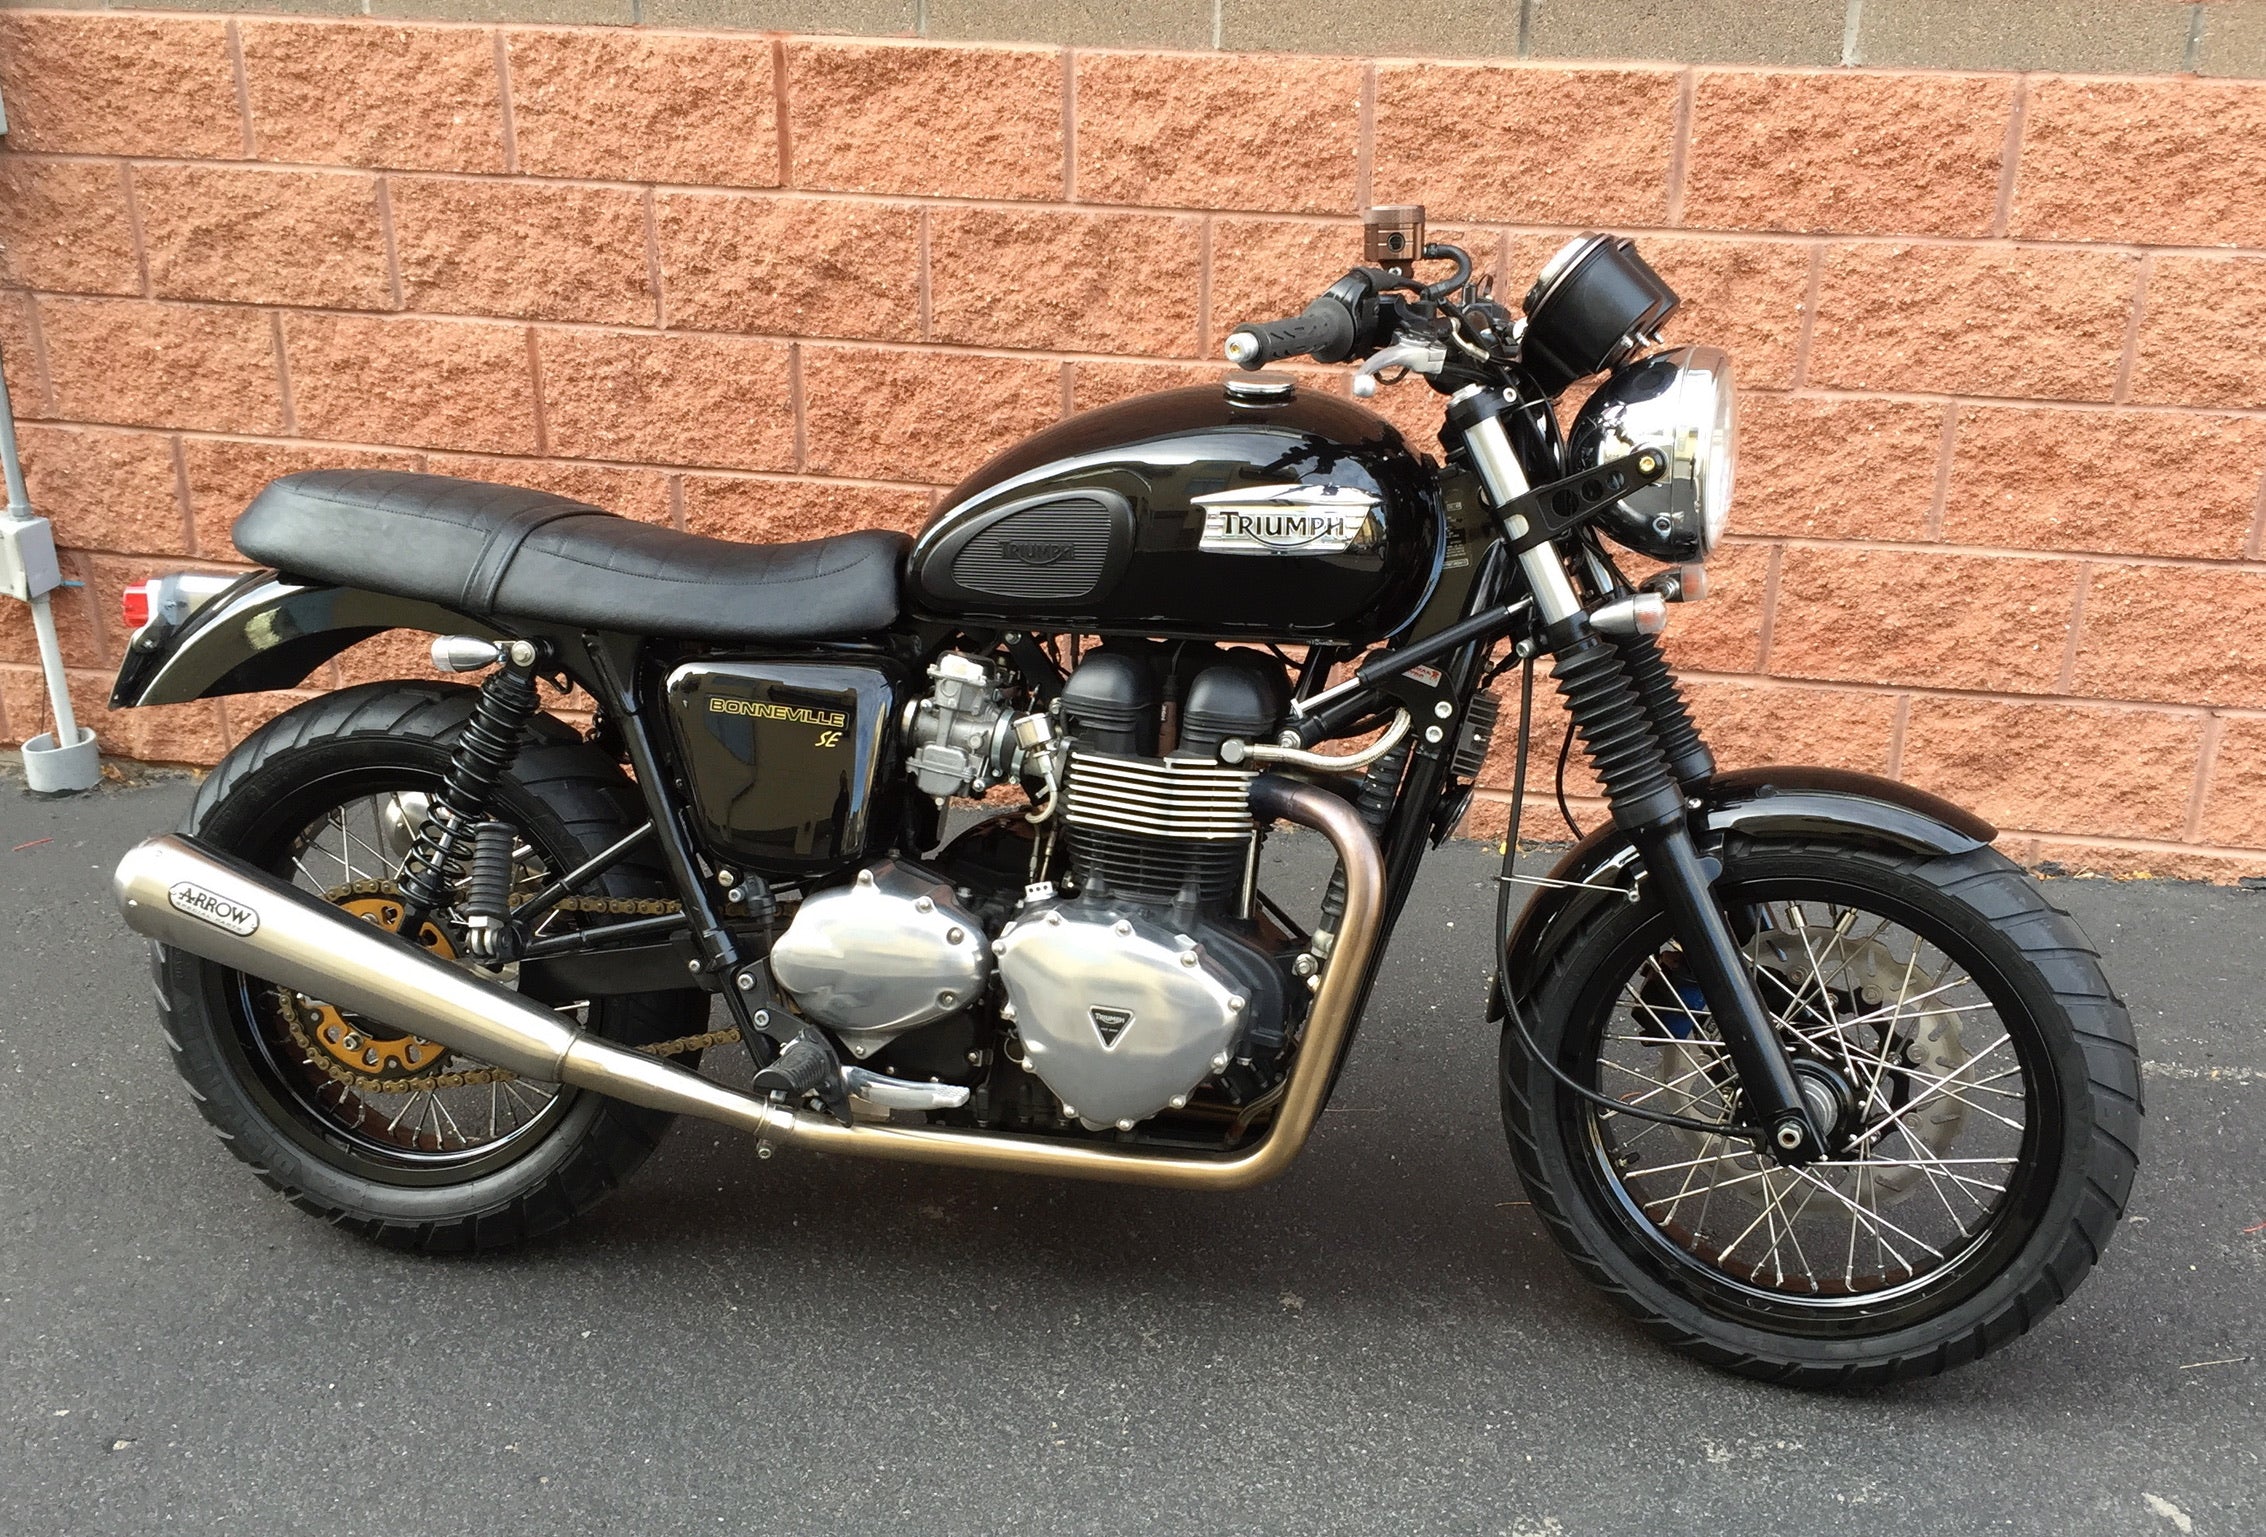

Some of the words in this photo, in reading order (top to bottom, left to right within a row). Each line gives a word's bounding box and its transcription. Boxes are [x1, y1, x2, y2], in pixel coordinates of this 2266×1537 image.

[1220, 511, 1344, 546] TRIUMPH
[709, 698, 846, 728] BONNEVILLE
[815, 731, 843, 748] SE
[178, 888, 251, 925] ARROW
[1095, 1013, 1125, 1024] TRIUMPH
